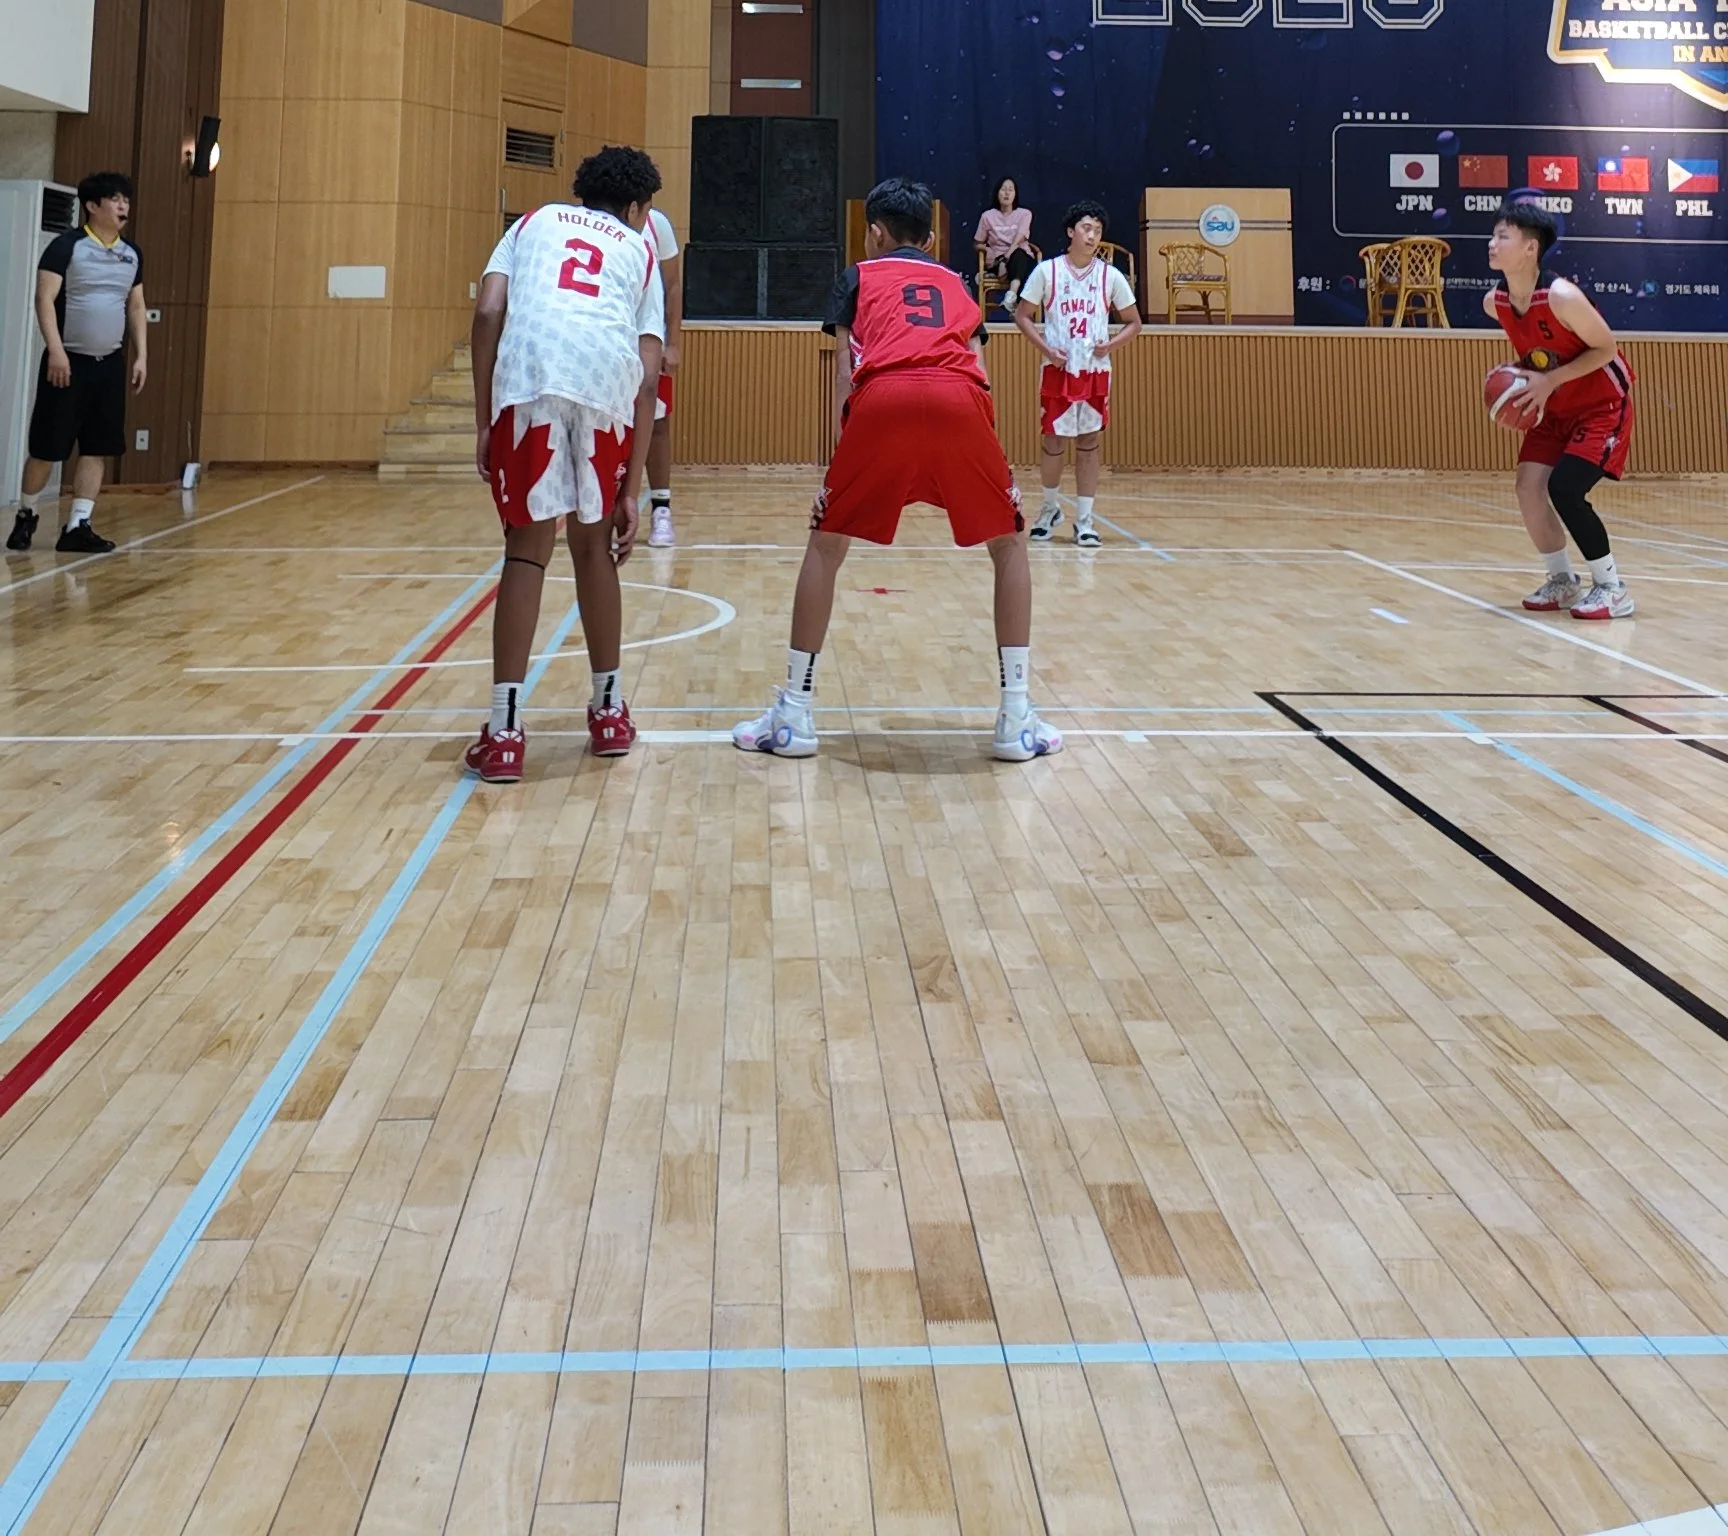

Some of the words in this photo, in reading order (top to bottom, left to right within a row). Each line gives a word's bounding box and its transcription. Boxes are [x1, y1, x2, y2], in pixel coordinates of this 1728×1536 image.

[1568, 19, 1710, 40] BASKETBALL
[1713, 21, 1728, 40] C
[1673, 45, 1696, 63] IN
[1395, 194, 1433, 212] JPN
[1464, 195, 1502, 212] CHN
[1605, 197, 1642, 215] TWN
[1675, 199, 1713, 217] PHL
[557, 211, 627, 242] HOLDER
[557, 237, 605, 298] 2
[902, 283, 945, 328] 9
[1069, 317, 1088, 339] 24
